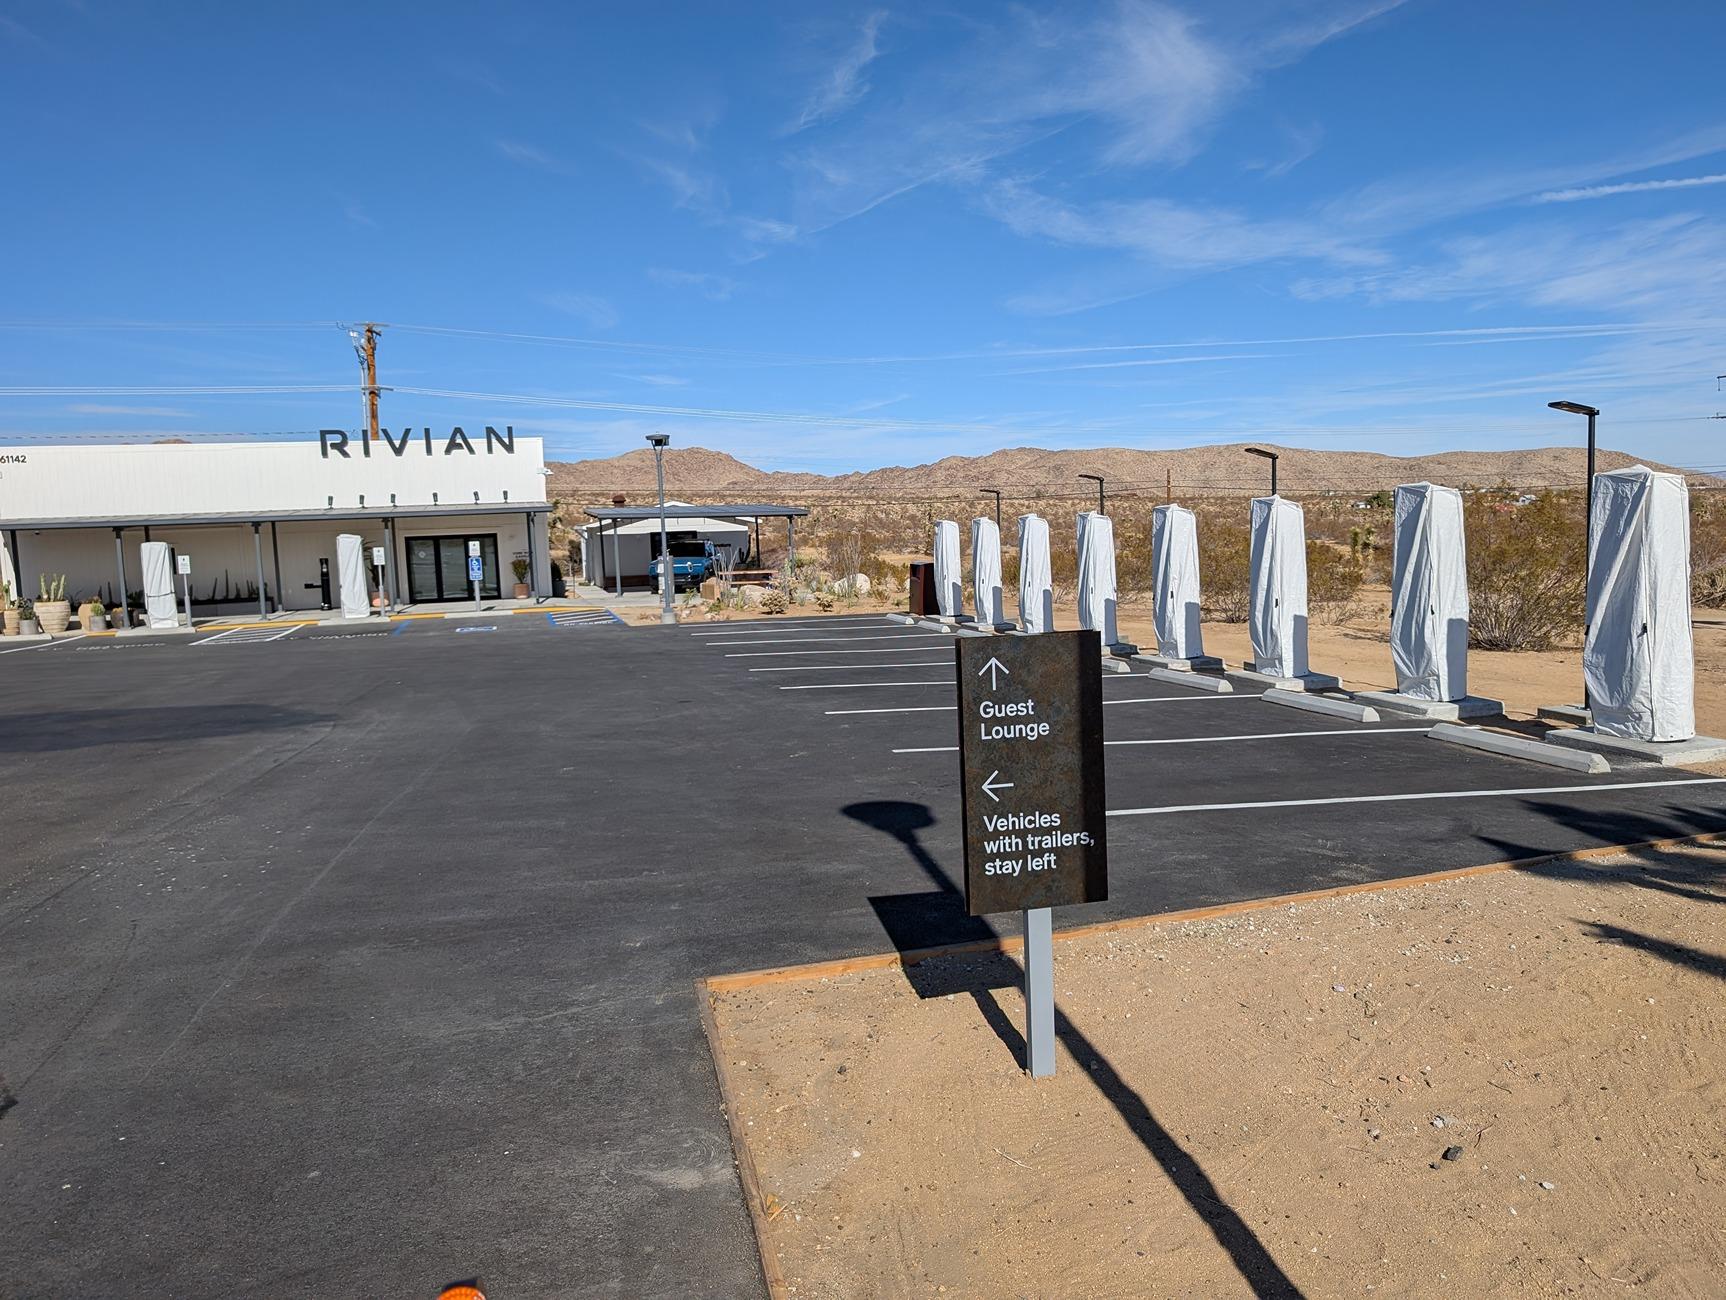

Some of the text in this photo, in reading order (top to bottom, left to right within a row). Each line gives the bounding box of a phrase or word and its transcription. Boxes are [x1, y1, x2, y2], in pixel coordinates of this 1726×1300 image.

[319, 426, 515, 459] RIVIAN
[0, 455, 27, 464] 61142
[979, 699, 1035, 719] Guest
[980, 721, 1050, 741] Lounge
[983, 811, 1061, 832] Vehicles
[984, 830, 1095, 854] with trailers,
[984, 853, 1057, 877] stay left
